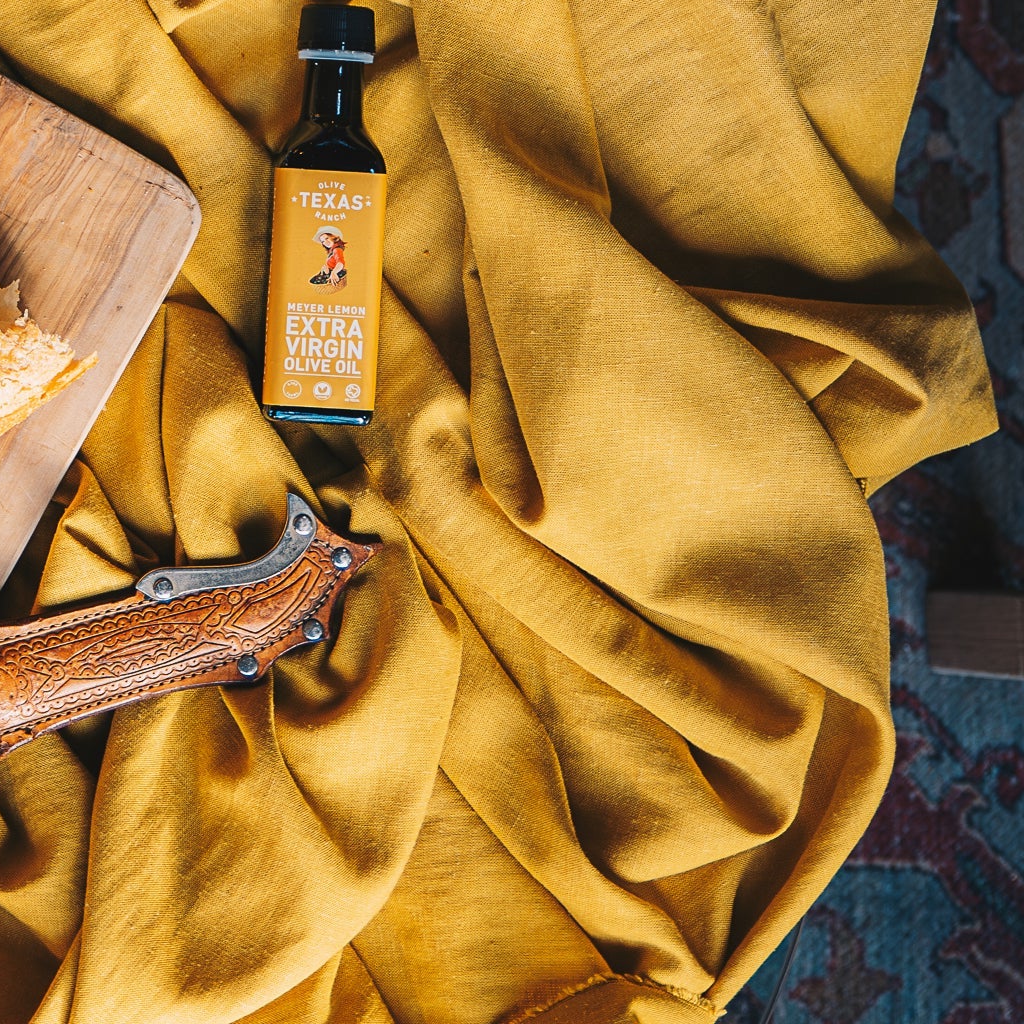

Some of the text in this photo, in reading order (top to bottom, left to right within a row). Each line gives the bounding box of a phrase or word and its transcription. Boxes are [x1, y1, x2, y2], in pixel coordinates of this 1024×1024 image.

[319, 182, 346, 190] OLIVE
[299, 192, 363, 210] TEXAS
[315, 211, 346, 221] RANCH
[287, 303, 366, 315] MEYER LEMON
[286, 316, 363, 339] EXTRA
[286, 337, 363, 359] VIRGIN
[284, 357, 361, 374] OLIVE OIL
